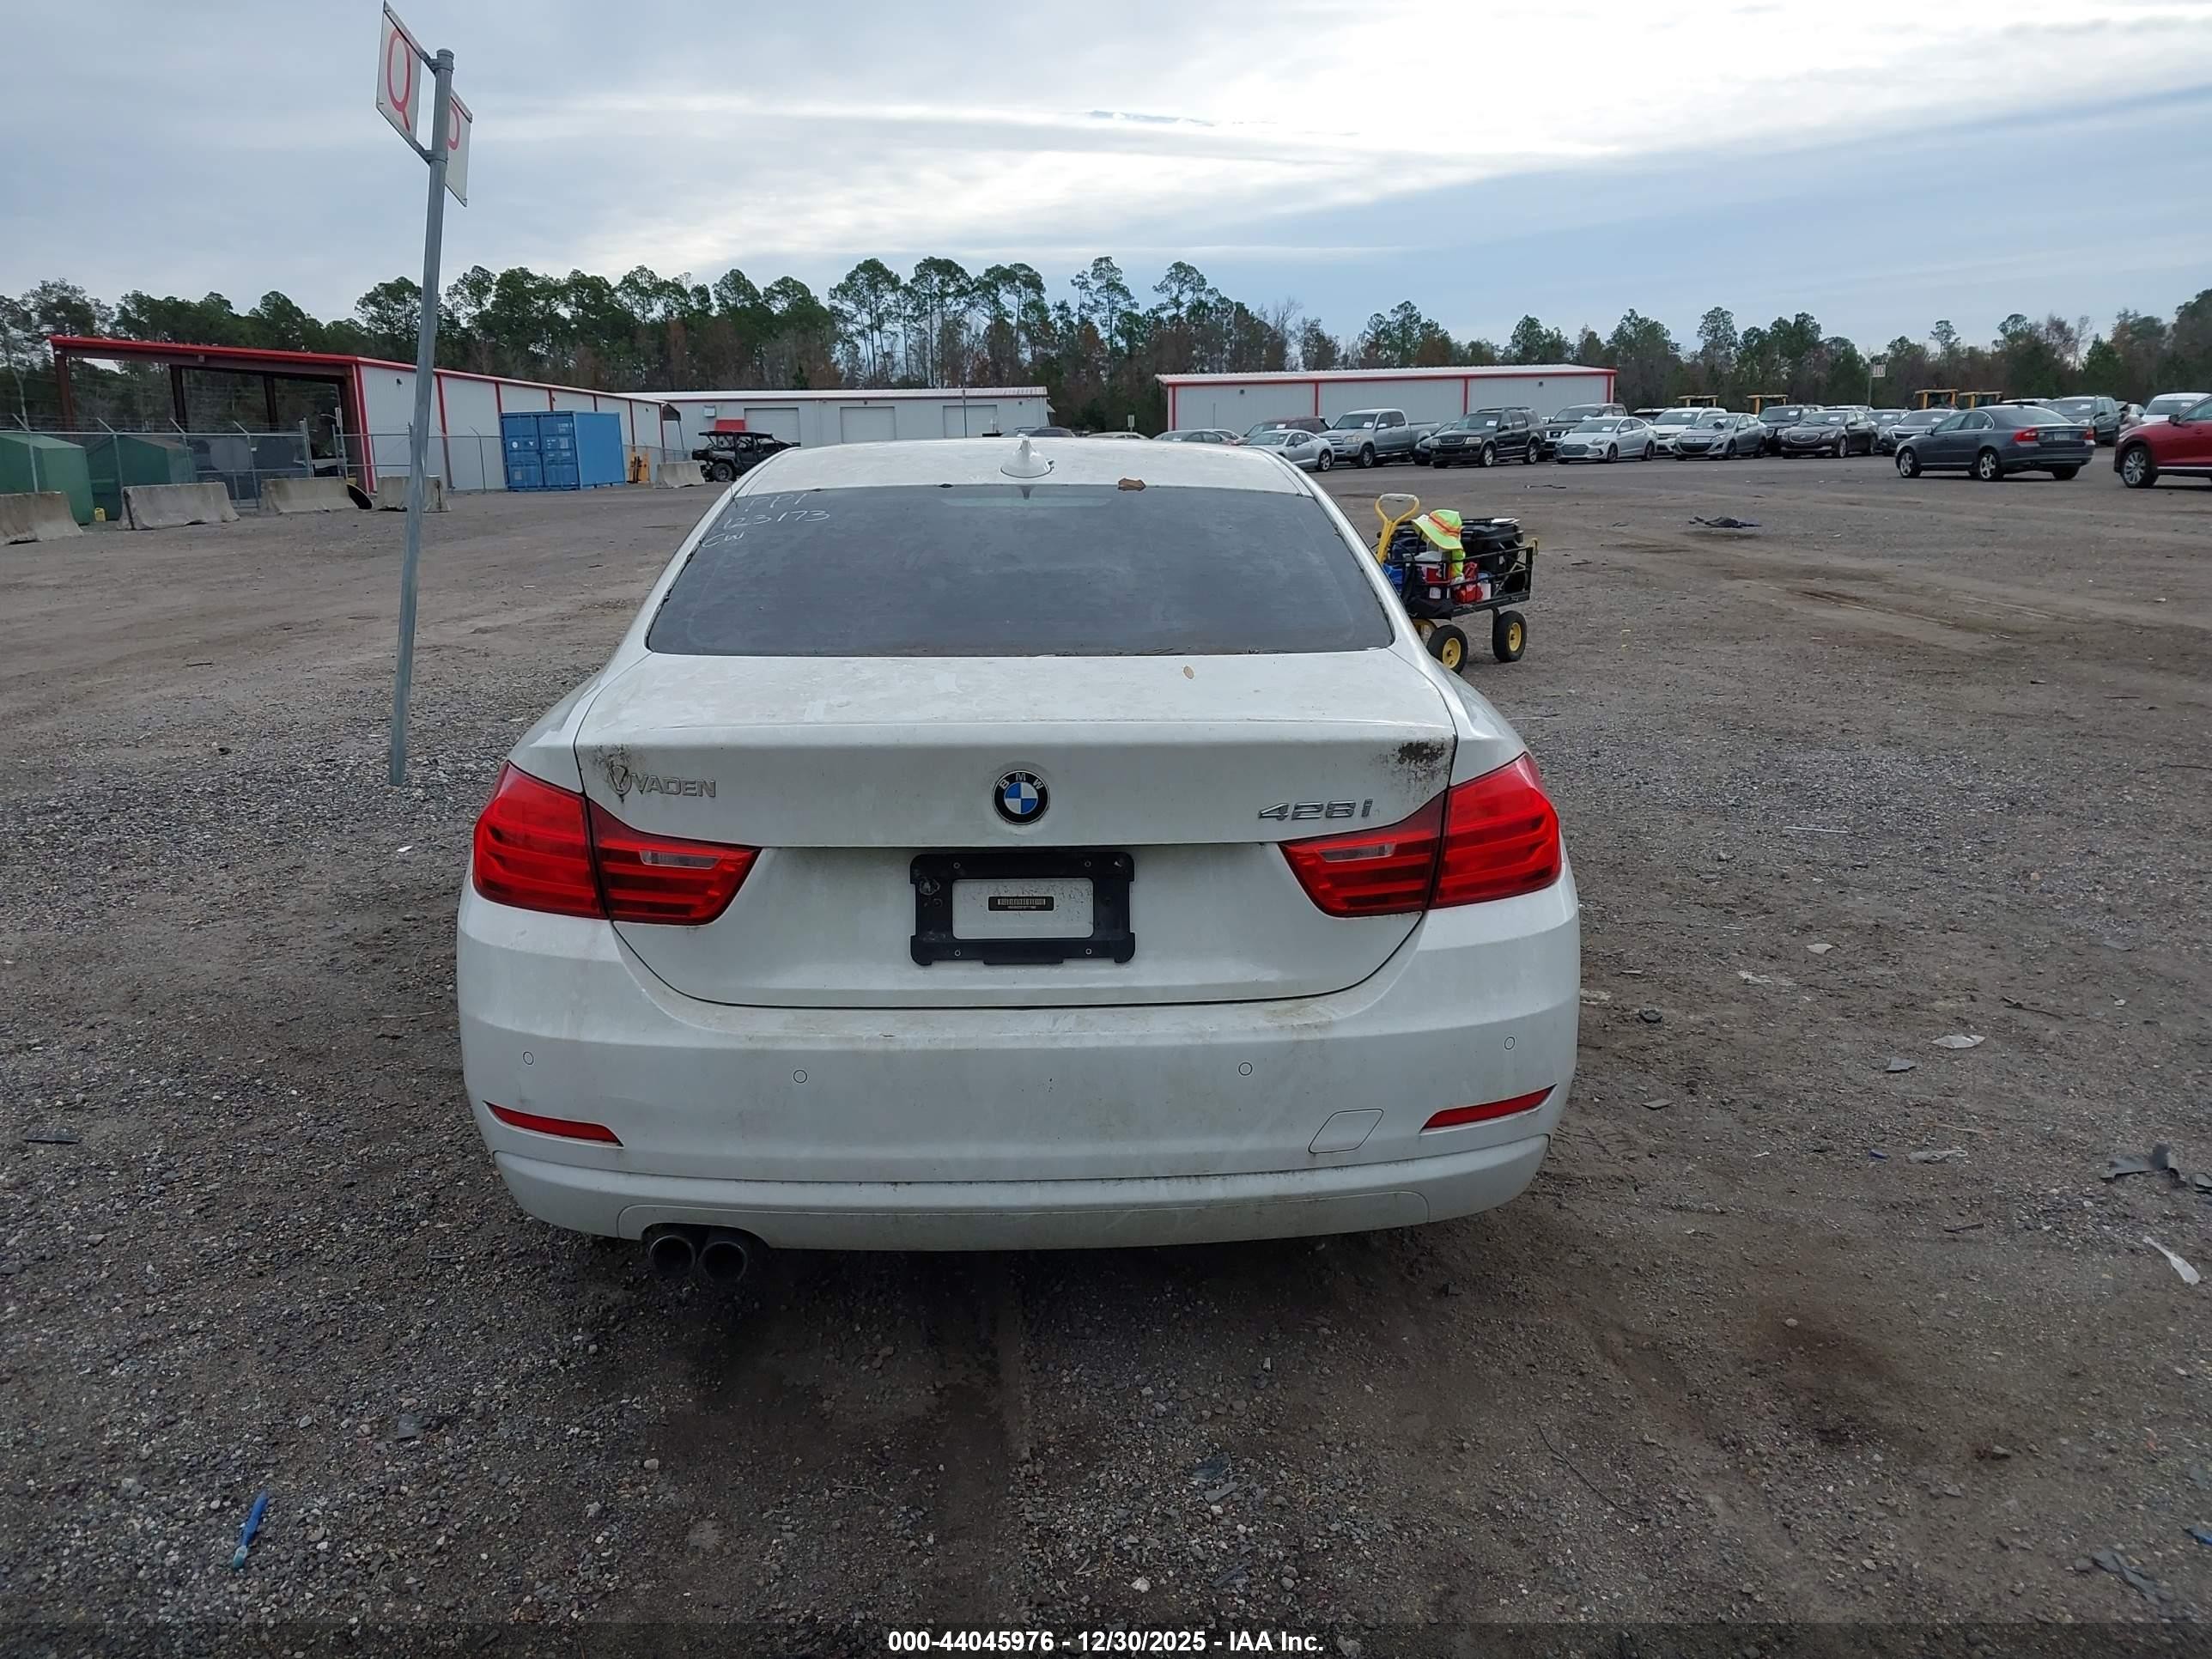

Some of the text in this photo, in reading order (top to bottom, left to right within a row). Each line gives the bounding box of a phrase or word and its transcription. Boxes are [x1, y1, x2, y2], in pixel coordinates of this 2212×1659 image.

[387, 27, 411, 132] Q
[723, 509, 831, 530] 123173
[631, 773, 716, 798] VADEN
[999, 772, 1044, 790] BMW
[1258, 798, 1374, 820] 428i
